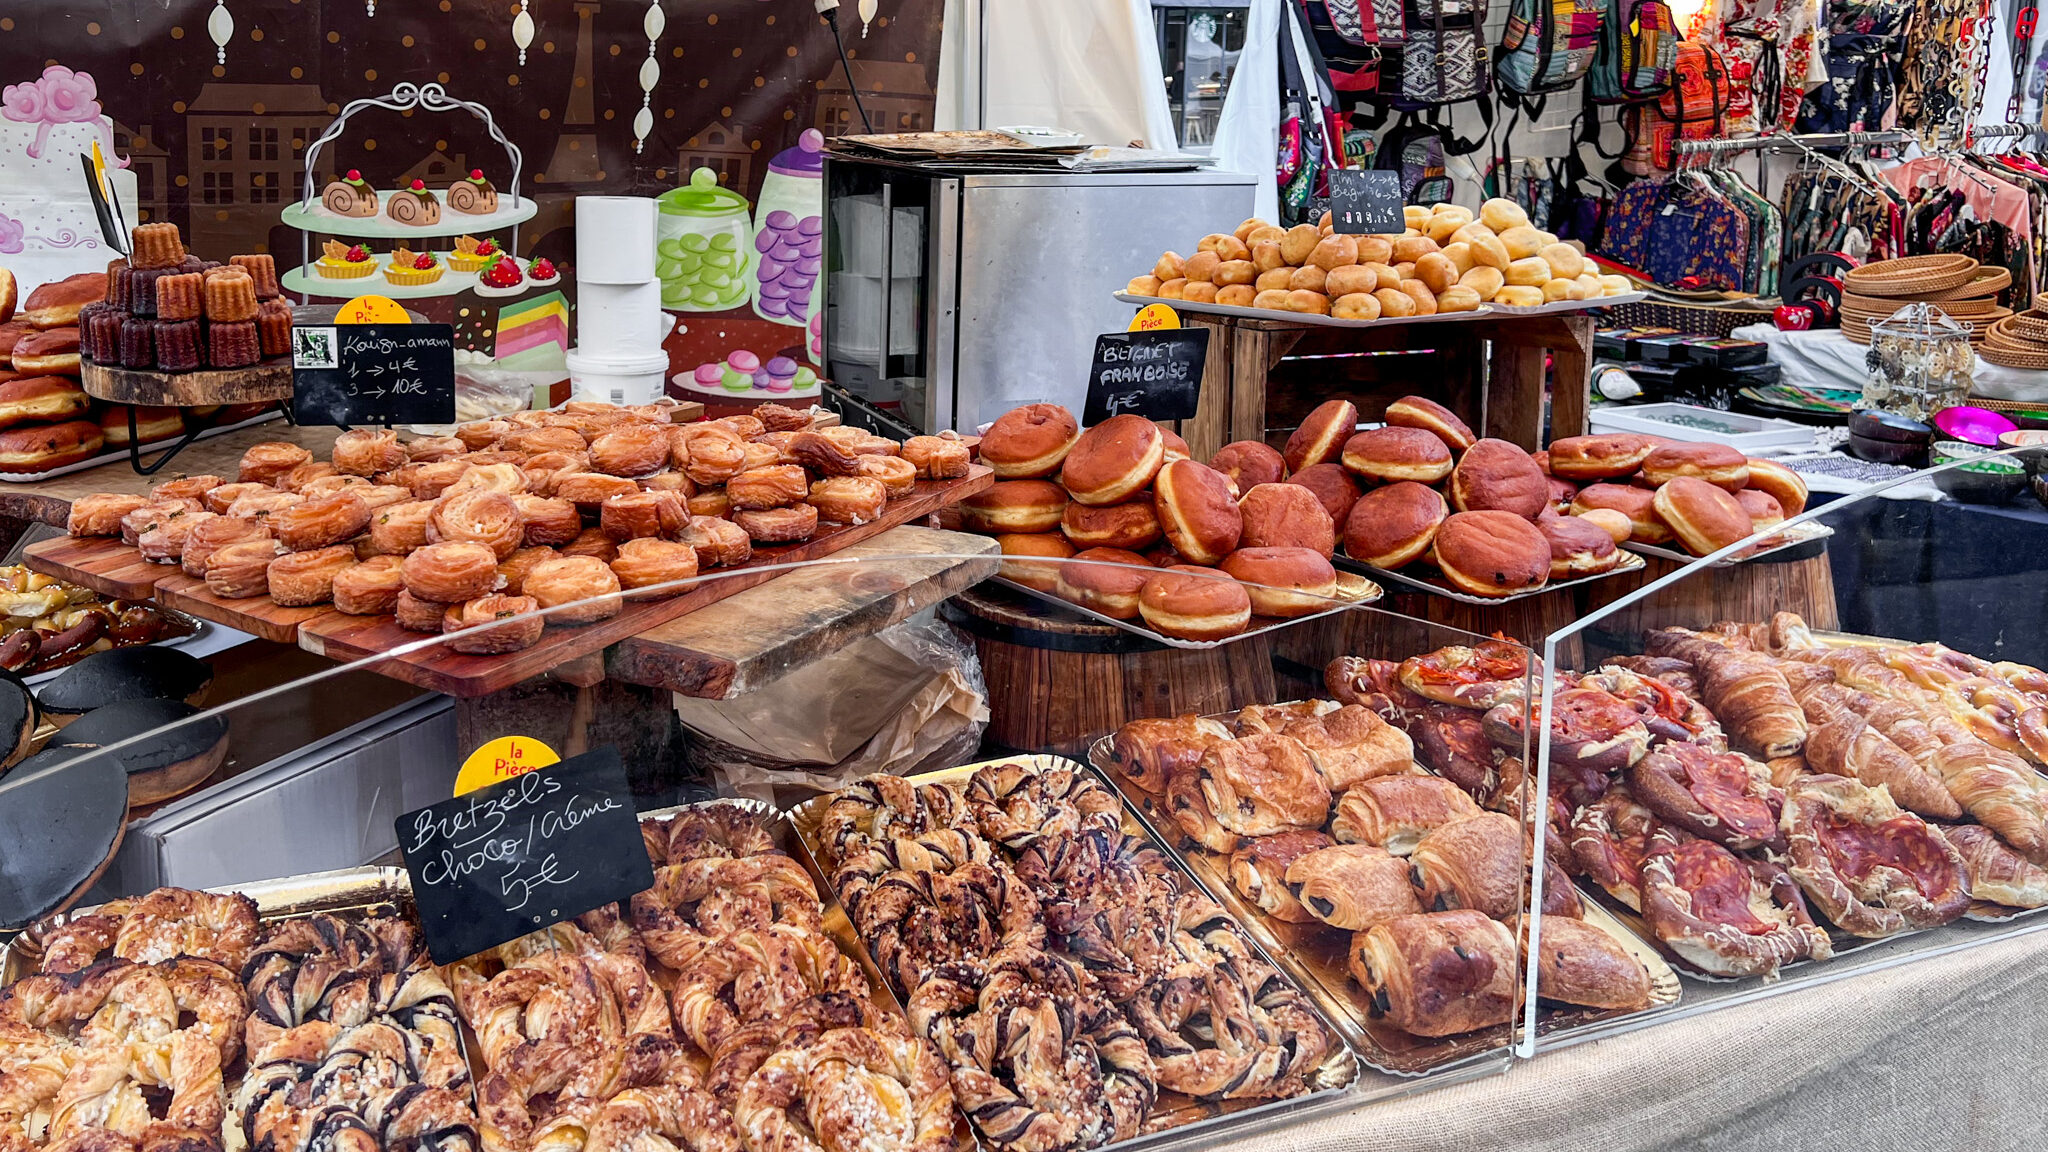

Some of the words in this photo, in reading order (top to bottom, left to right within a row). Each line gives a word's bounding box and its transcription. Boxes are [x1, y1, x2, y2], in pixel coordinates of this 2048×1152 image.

[1332, 184, 1374, 202] Beignts
[1375, 188, 1382, 198] 6
[1147, 307, 1155, 318] la
[1141, 318, 1163, 331] Pièce
[1103, 342, 1183, 363] BEIGNET
[388, 356, 419, 374] 4€
[1100, 358, 1190, 386] FRAMBOISE
[346, 382, 359, 397] 3
[391, 378, 428, 395] 10€
[510, 741, 523, 759] la
[408, 771, 562, 854] Bretzels
[500, 853, 580, 911] 5€
